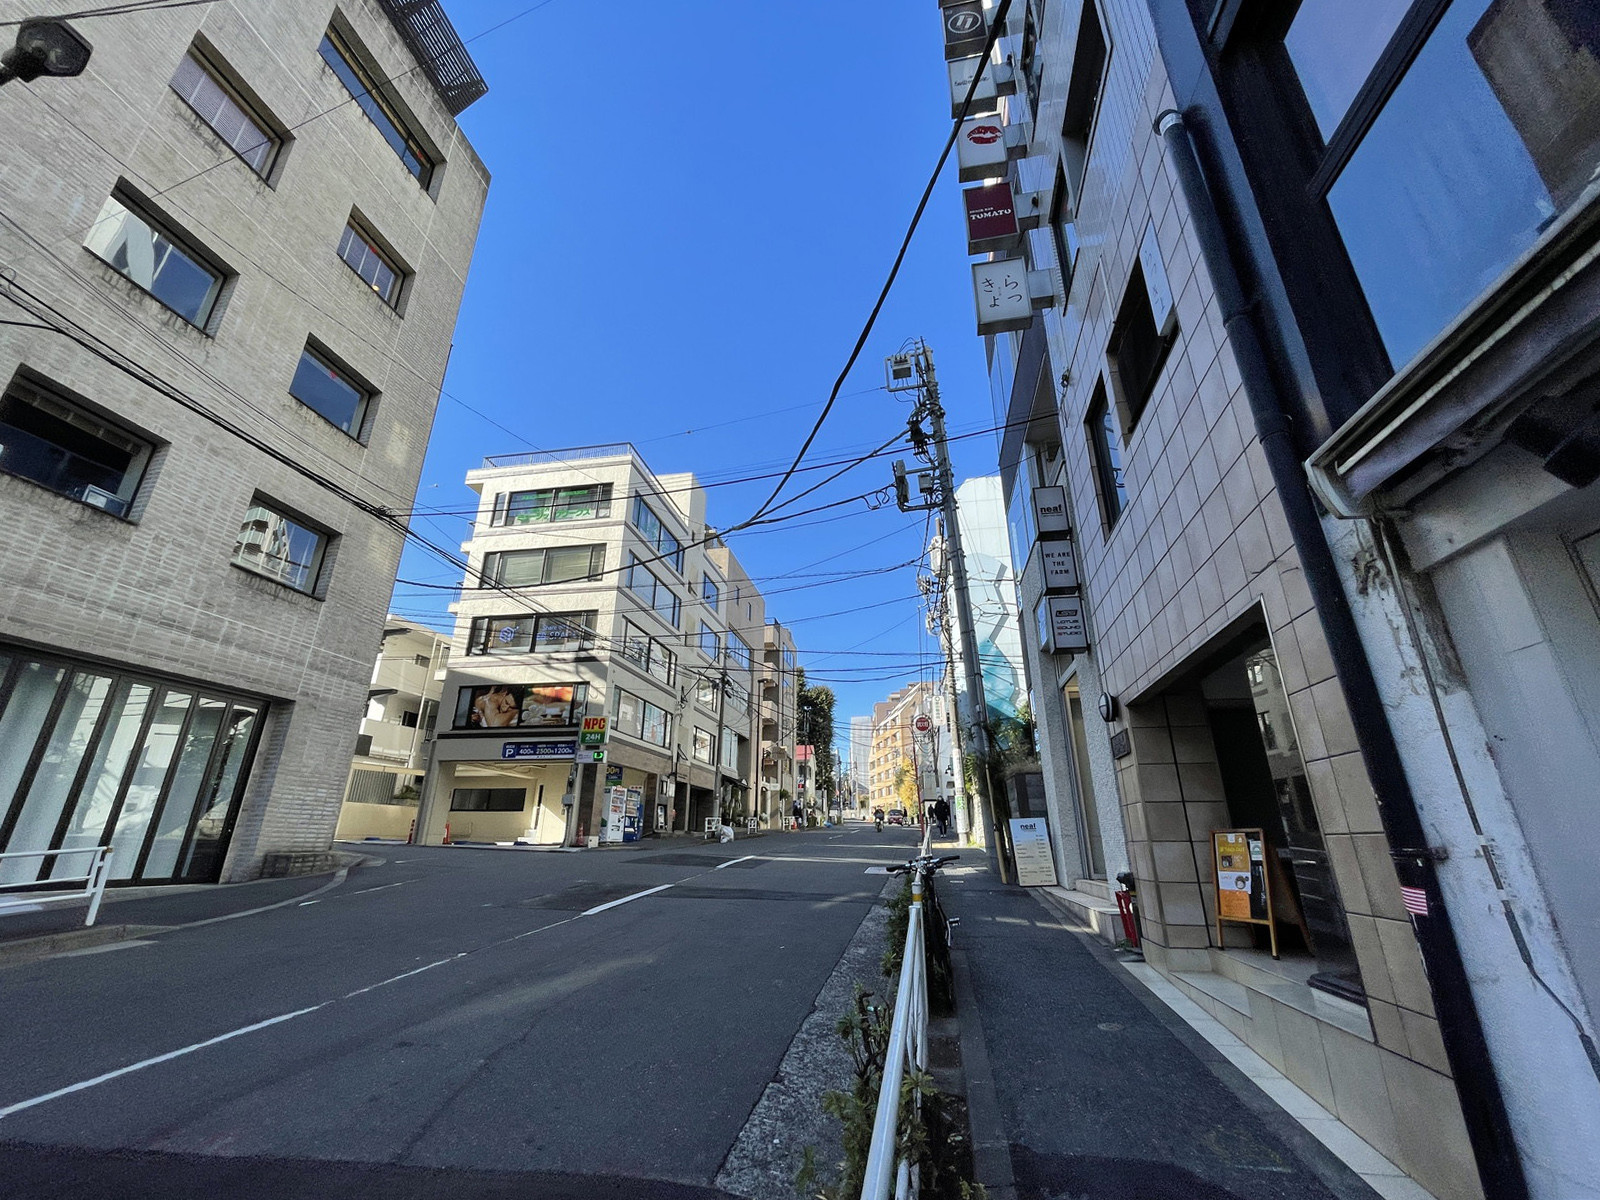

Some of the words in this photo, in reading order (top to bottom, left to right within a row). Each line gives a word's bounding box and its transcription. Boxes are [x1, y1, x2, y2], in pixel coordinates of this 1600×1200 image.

[970, 208, 1012, 220] TOMATO
[584, 718, 606, 730] NPC
[585, 733, 601, 741] 24H
[505, 749, 514, 758] P
